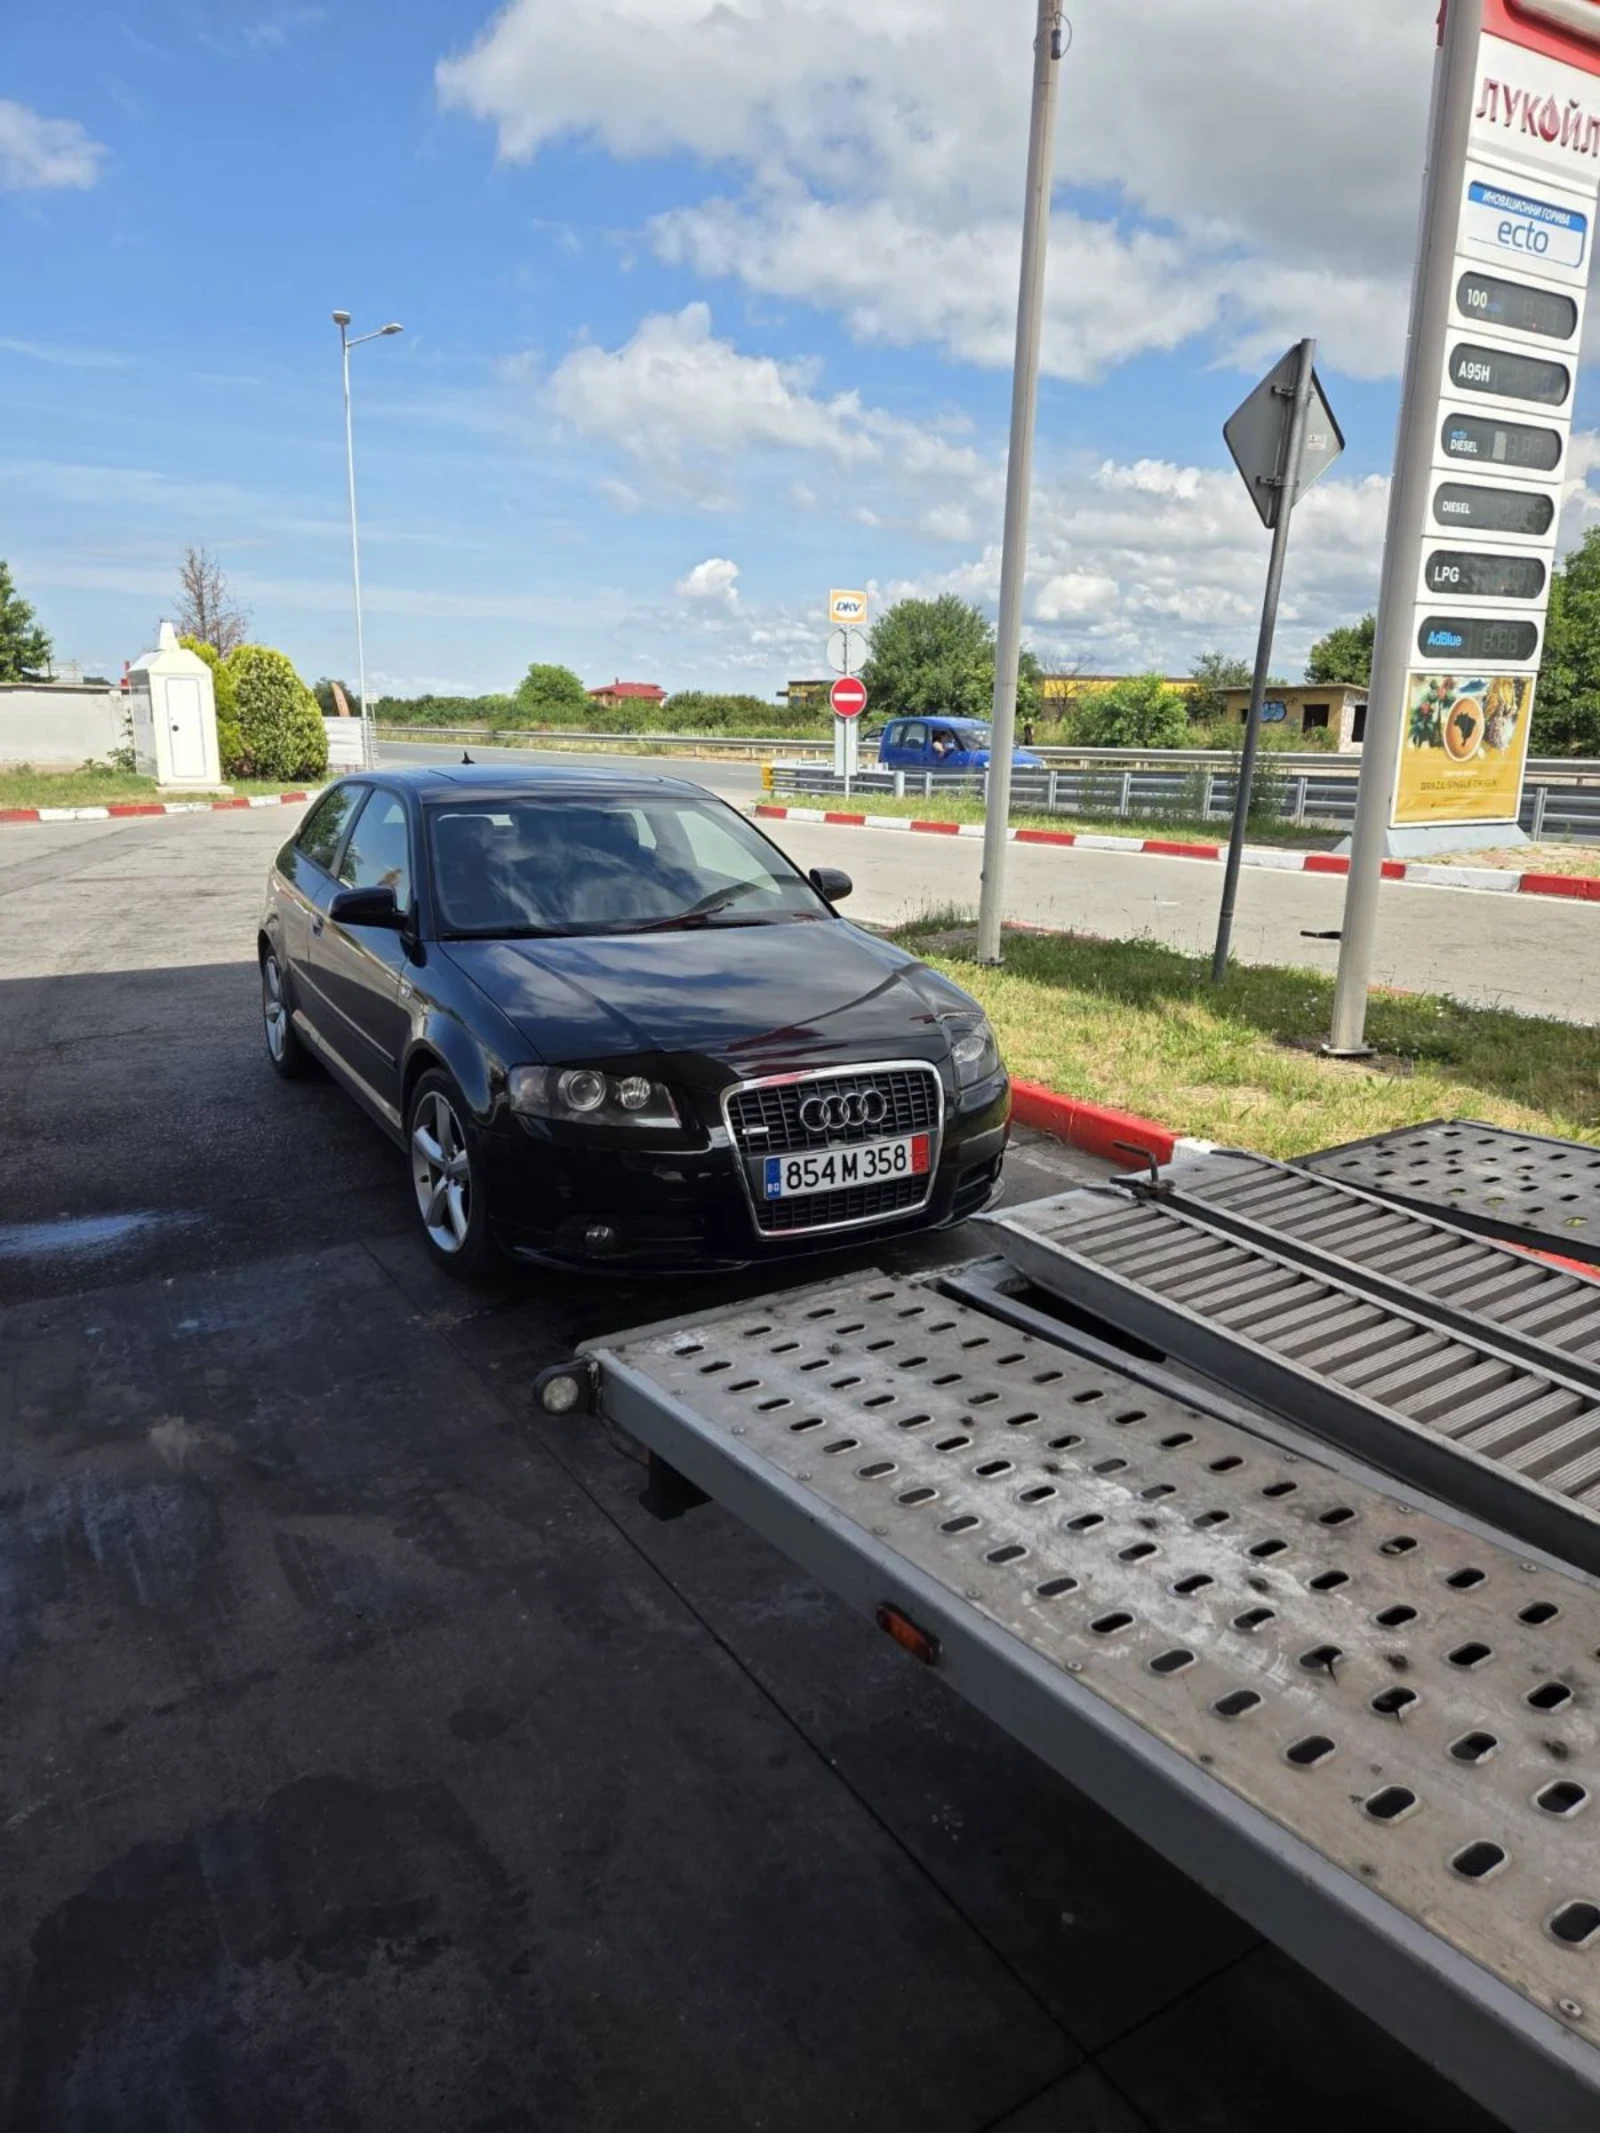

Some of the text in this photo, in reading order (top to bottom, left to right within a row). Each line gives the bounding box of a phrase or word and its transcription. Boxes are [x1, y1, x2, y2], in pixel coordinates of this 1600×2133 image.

[1475, 77, 1600, 158] ЛУКОЙЛ
[1497, 220, 1549, 254] ecto
[1467, 288, 1488, 308] 100
[1458, 361, 1491, 383] A95H
[1450, 439, 1478, 453] DIESEL
[1442, 501, 1471, 514] DIESEL
[1434, 566, 1460, 583] LPG
[836, 601, 862, 612] DKV
[1427, 631, 1462, 647] AdBlue
